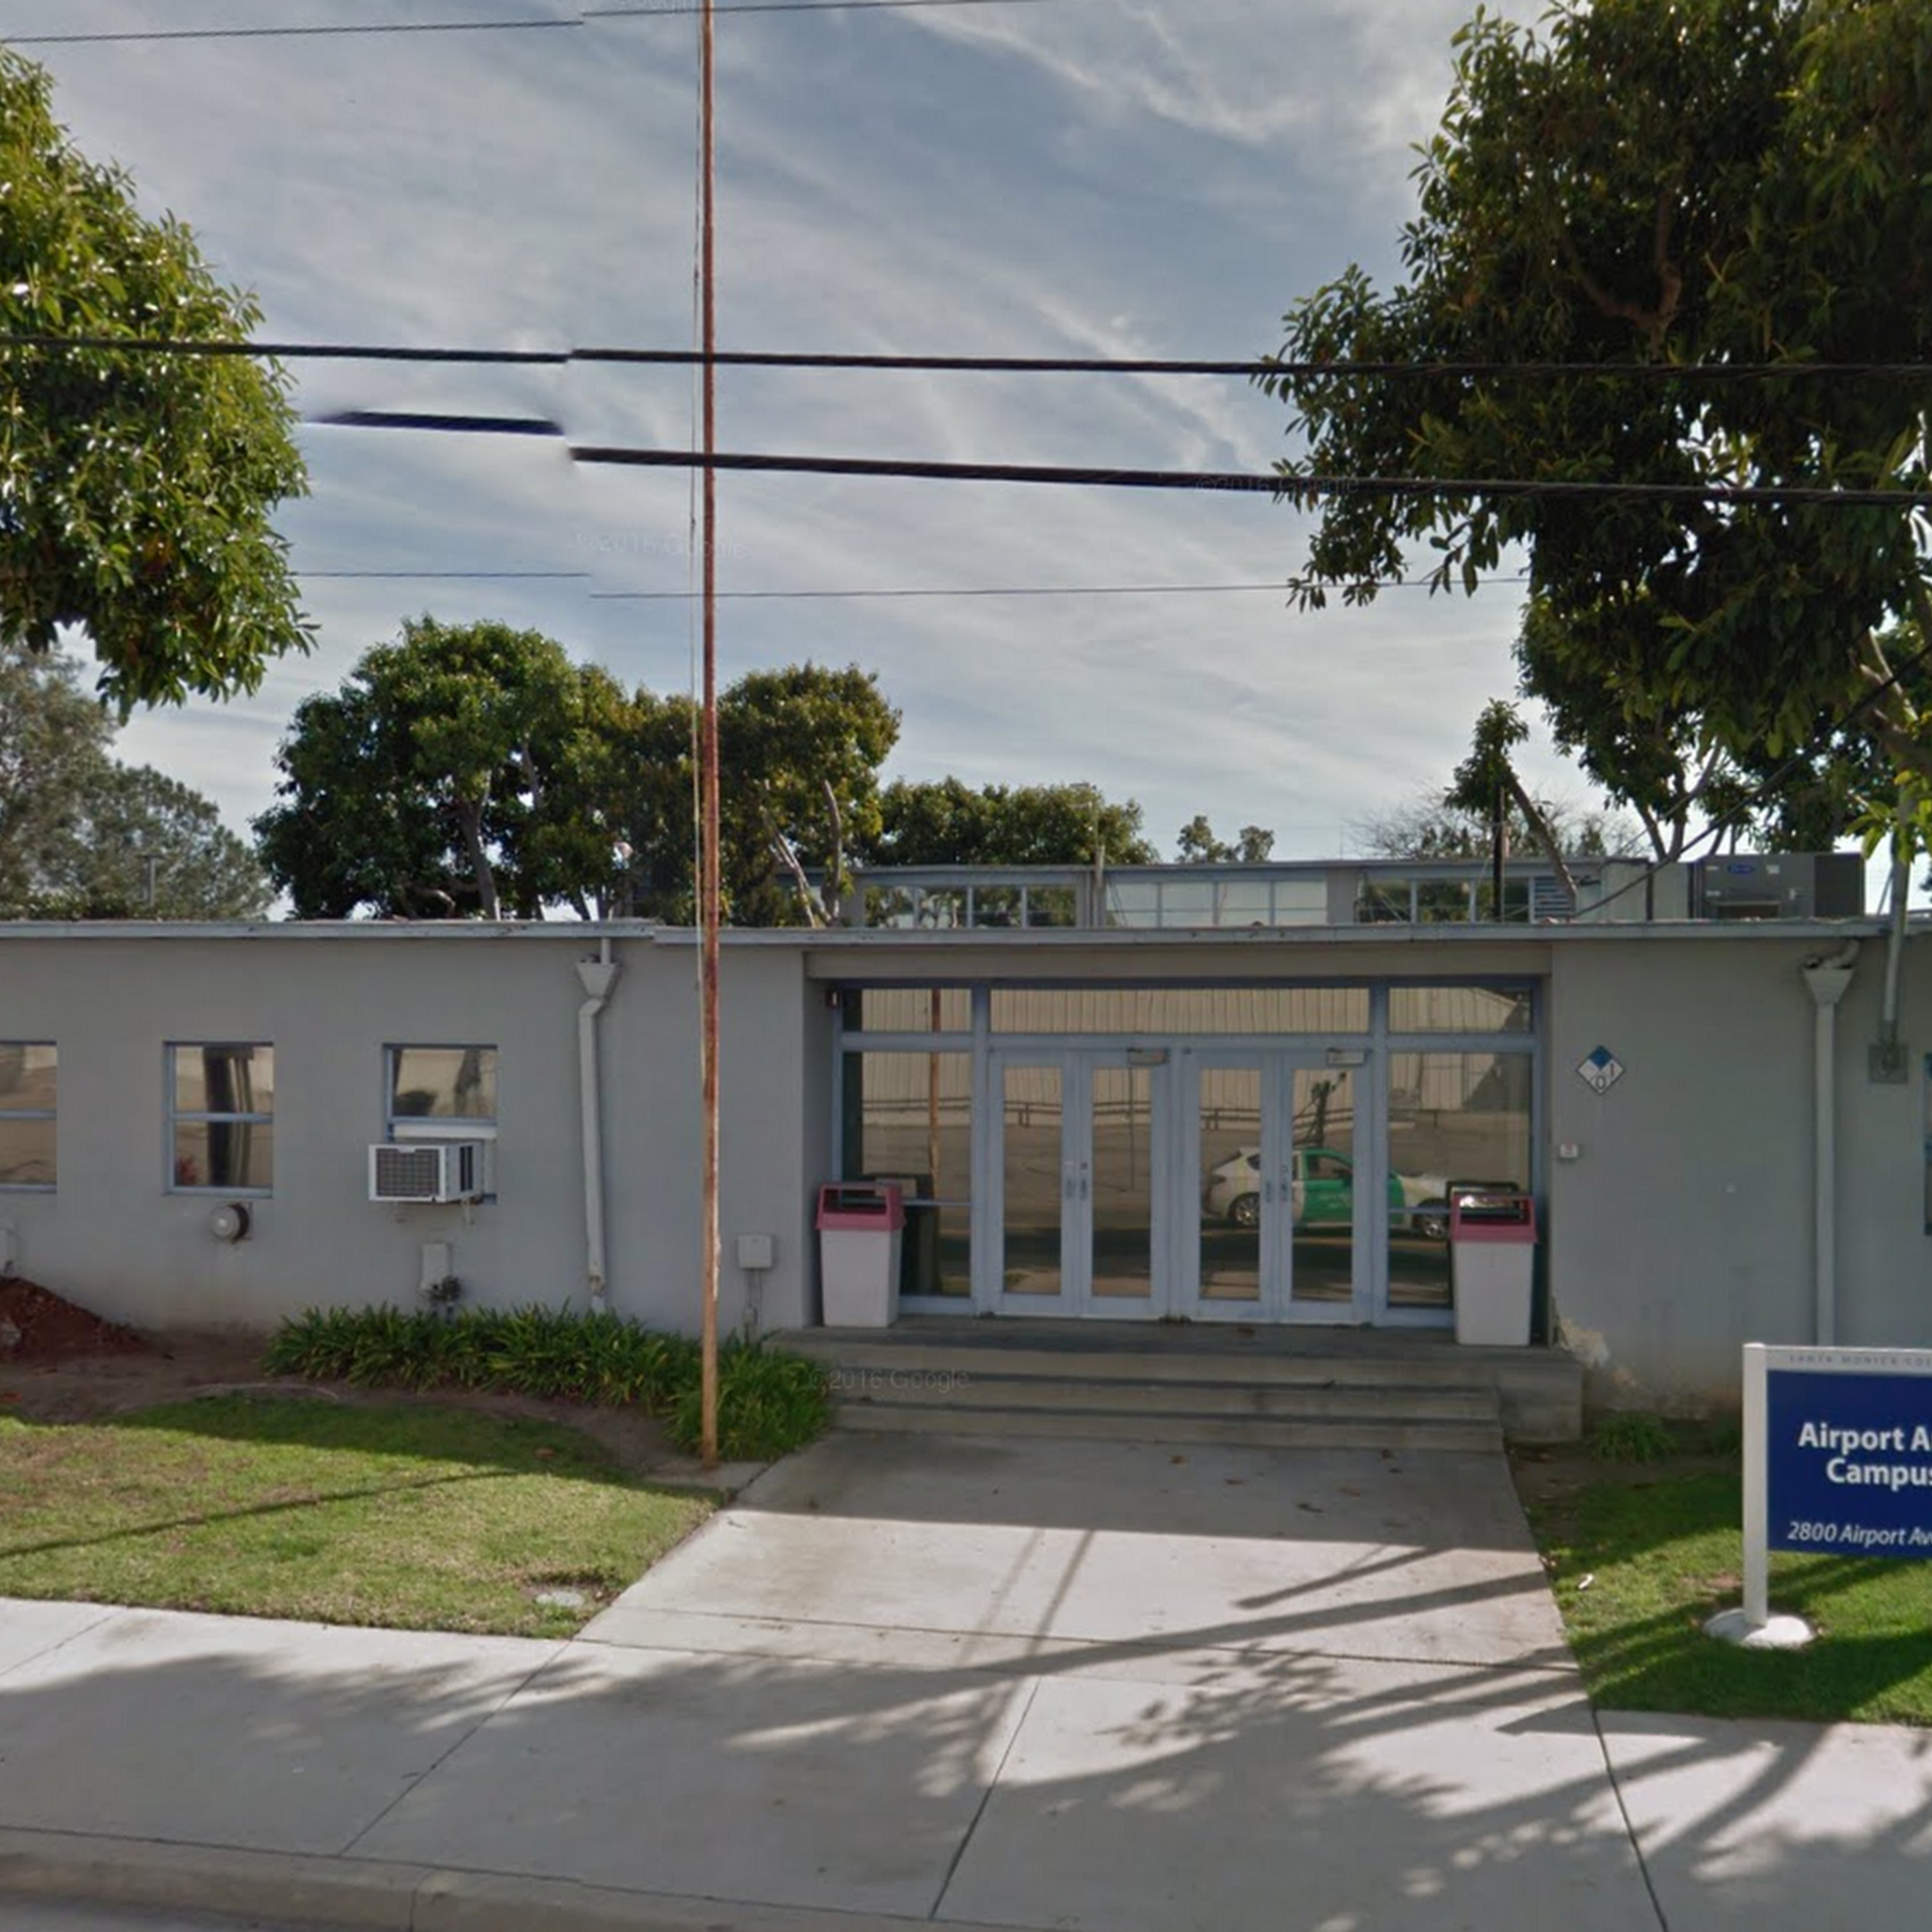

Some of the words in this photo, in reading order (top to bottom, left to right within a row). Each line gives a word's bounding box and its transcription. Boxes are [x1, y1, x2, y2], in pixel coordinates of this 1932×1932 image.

[1798, 1422, 1904, 1456] Airport
[1910, 1426, 1932, 1451] A
[1787, 1520, 1836, 1541] 2800
[1839, 1524, 1906, 1548] Airport
[1908, 1526, 1932, 1546] Av
